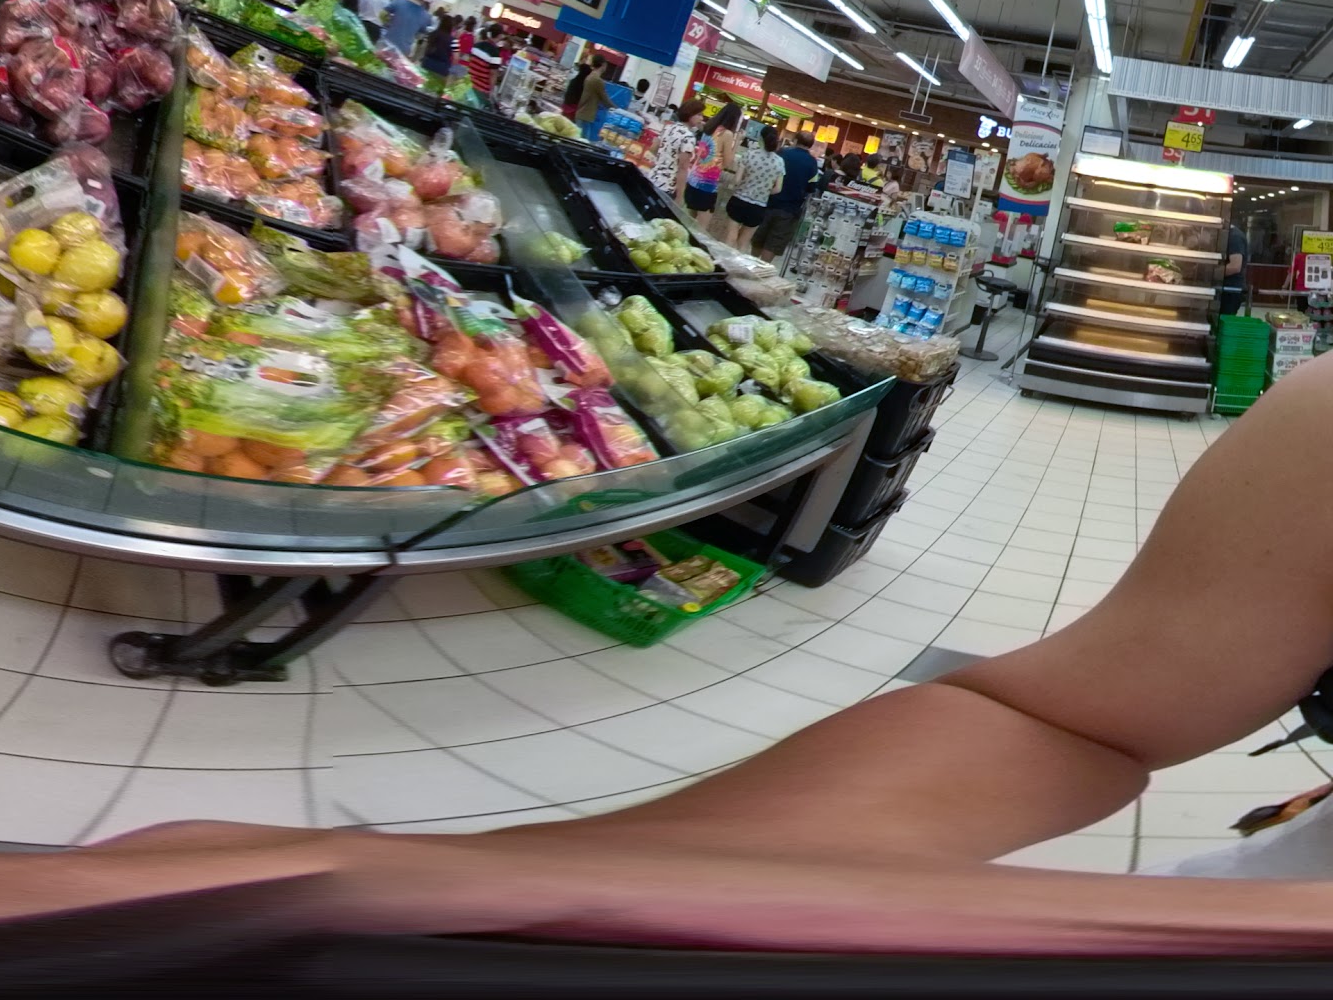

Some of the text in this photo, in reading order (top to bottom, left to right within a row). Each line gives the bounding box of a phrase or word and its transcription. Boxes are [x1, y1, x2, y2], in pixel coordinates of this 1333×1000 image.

[687, 21, 705, 40] 29
[711, 70, 735, 85] Thank
[734, 78, 750, 90] You
[1018, 139, 1059, 150] Delicacies
[847, 179, 880, 195] Energizer
